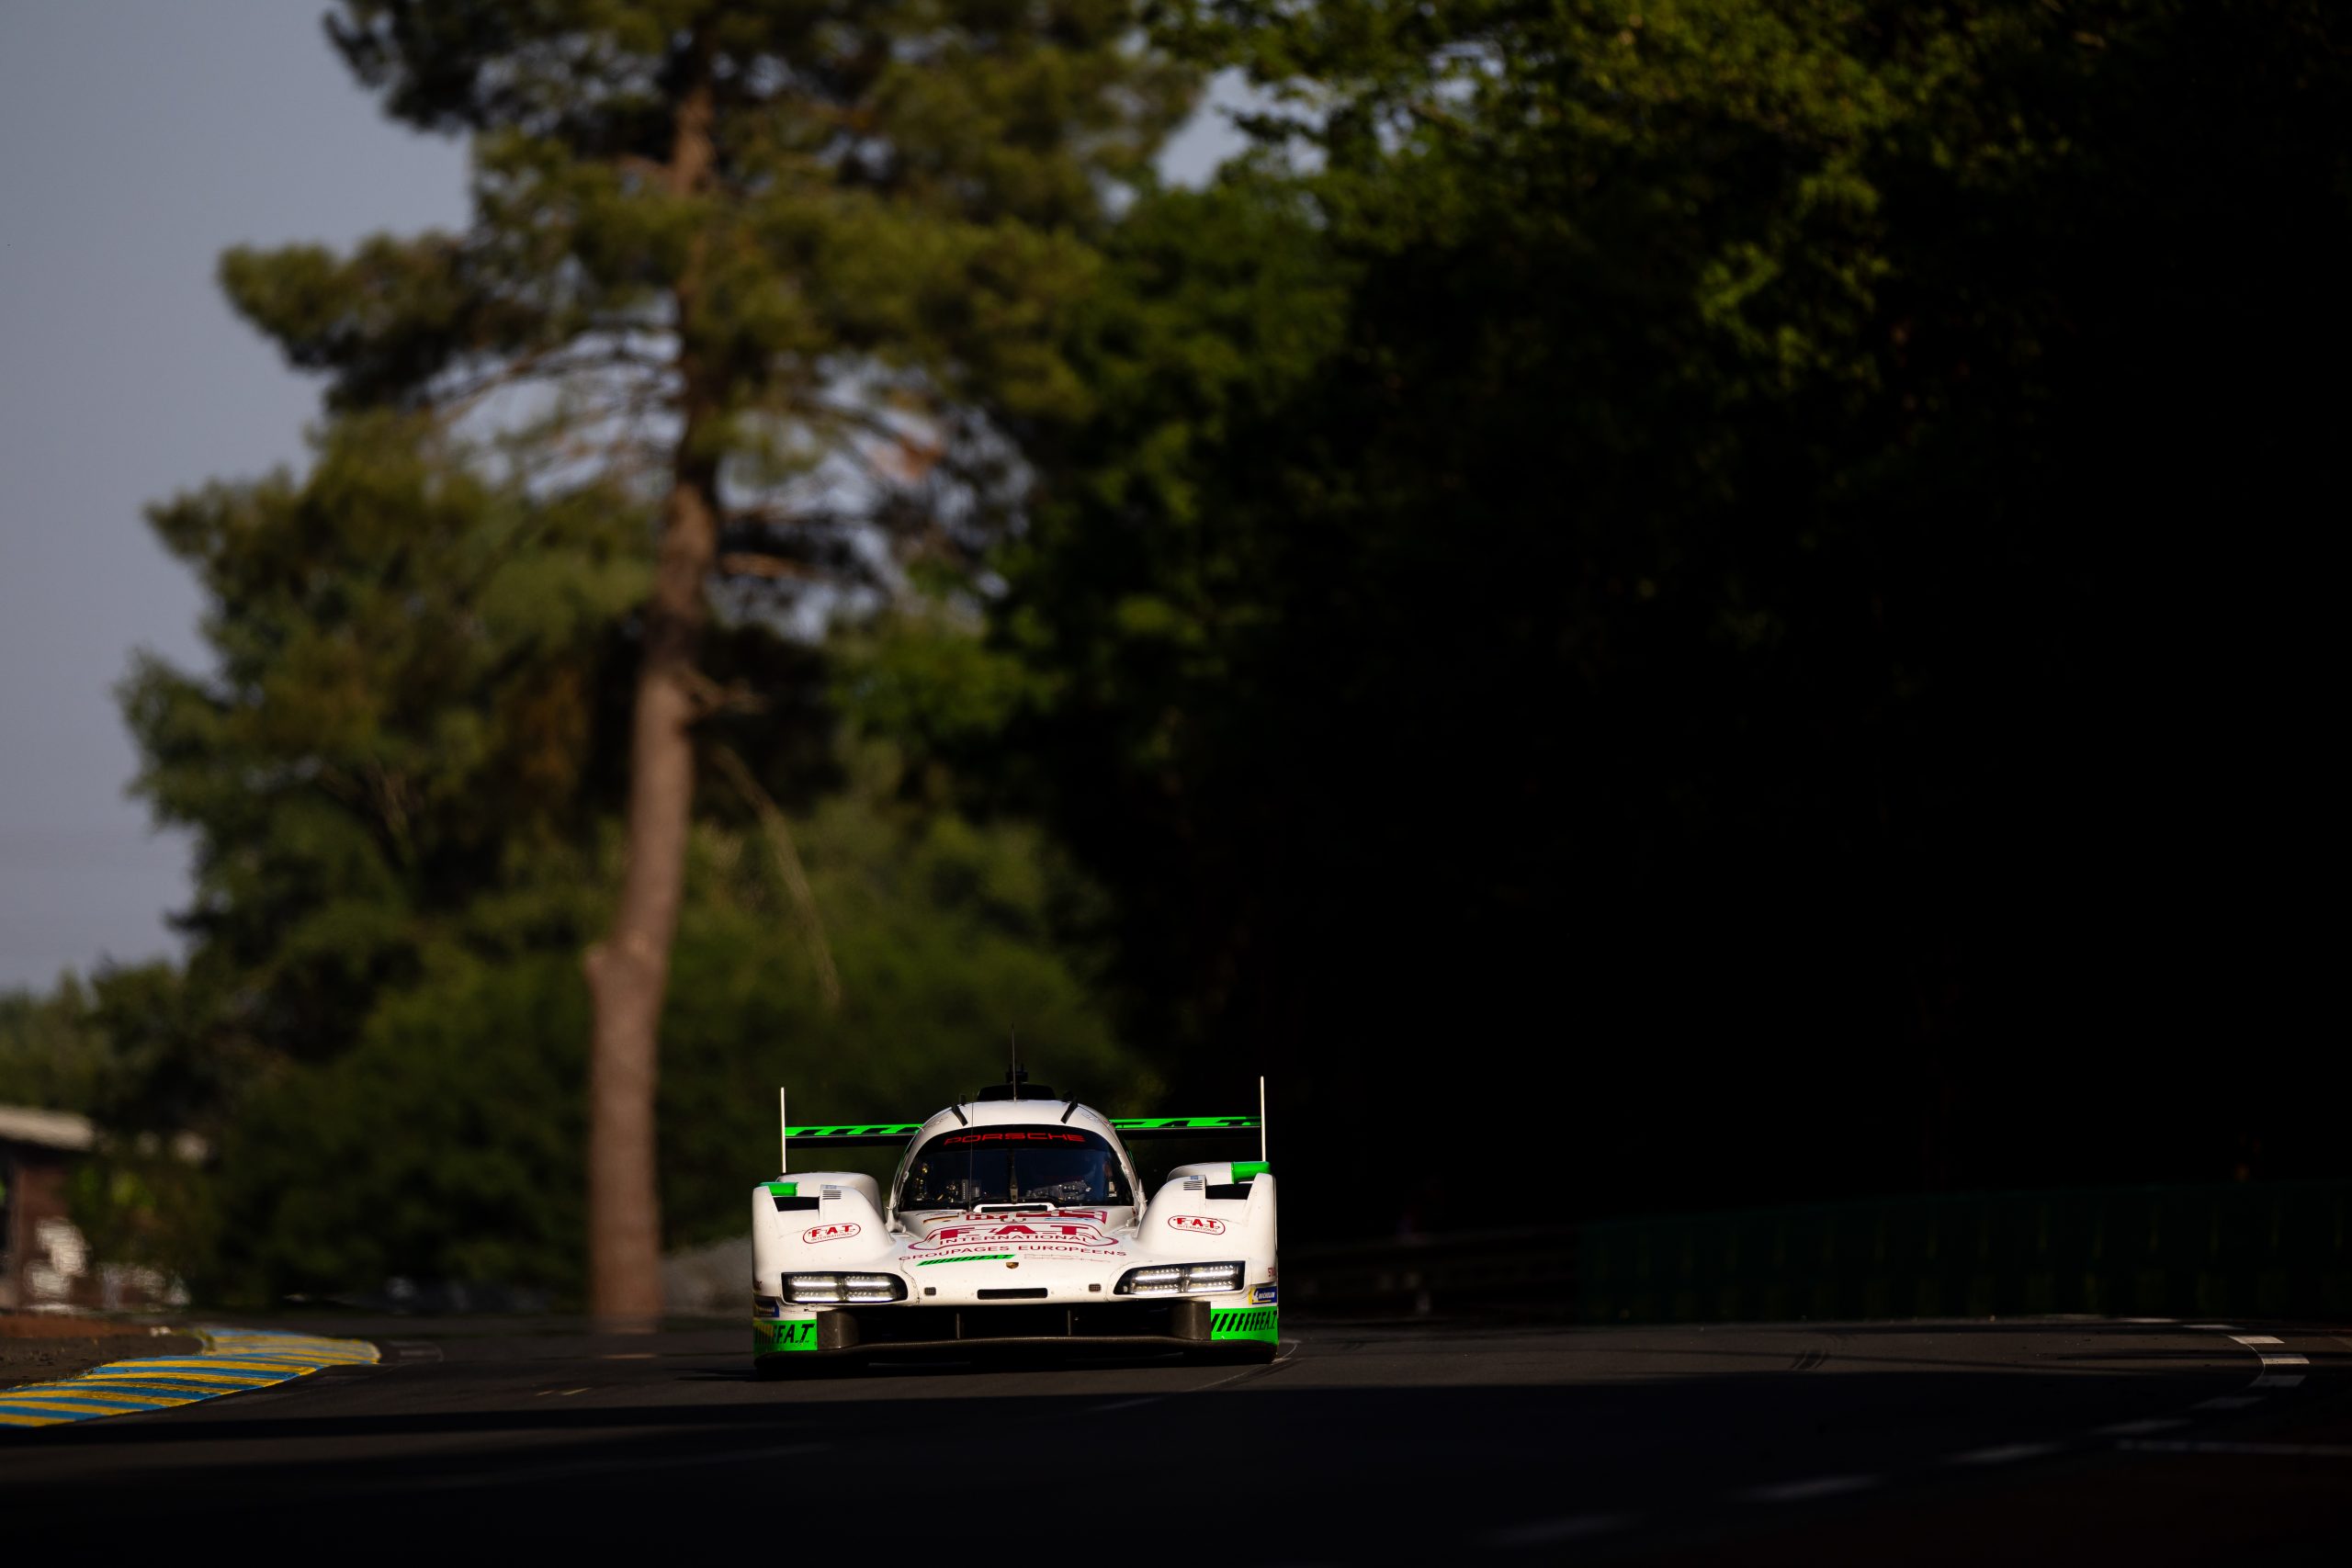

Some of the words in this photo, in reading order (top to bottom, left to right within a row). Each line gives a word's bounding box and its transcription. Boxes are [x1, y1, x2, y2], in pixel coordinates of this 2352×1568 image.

[944, 1133, 1086, 1145] PORSCHE
[940, 1235, 1089, 1246] INTERNATIONAL
[899, 1246, 1010, 1261] GROUPAGES
